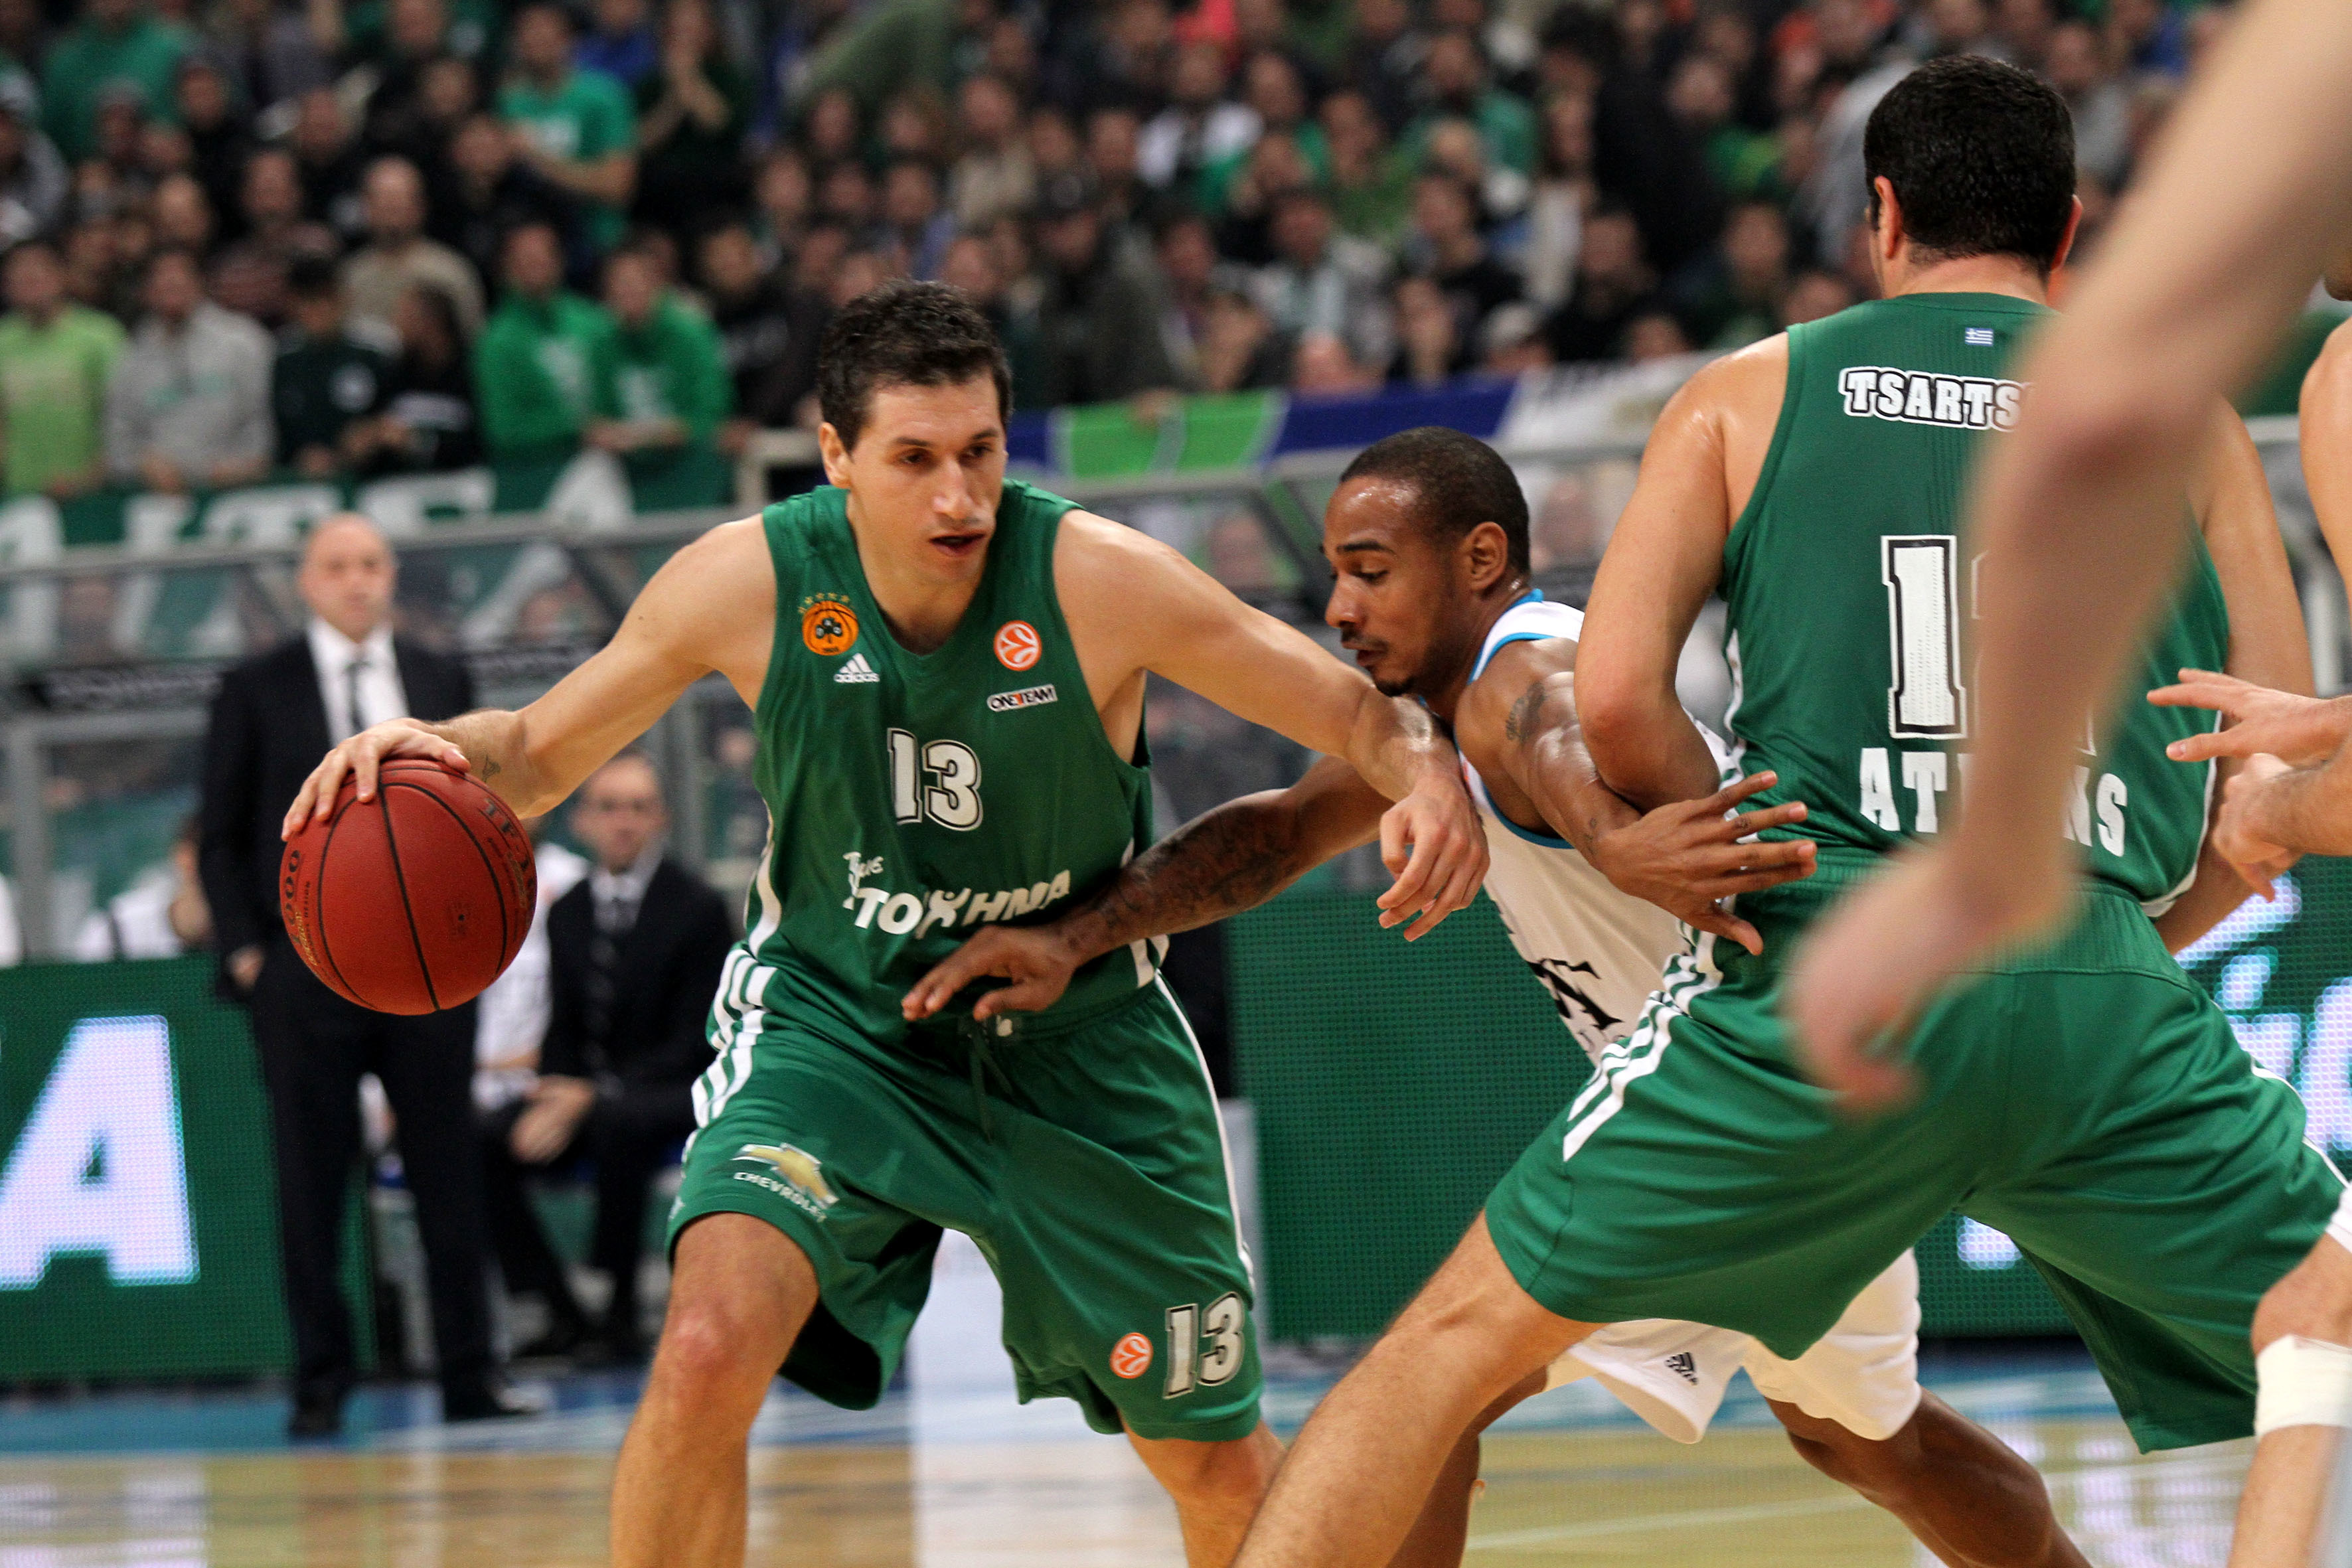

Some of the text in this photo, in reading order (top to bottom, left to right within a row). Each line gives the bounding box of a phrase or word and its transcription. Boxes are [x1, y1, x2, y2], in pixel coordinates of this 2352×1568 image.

[1838, 366, 2033, 432] TSARTS
[887, 728, 983, 831] 13
[1859, 747, 2128, 856] ATNS
[1163, 1291, 1245, 1399] 13
